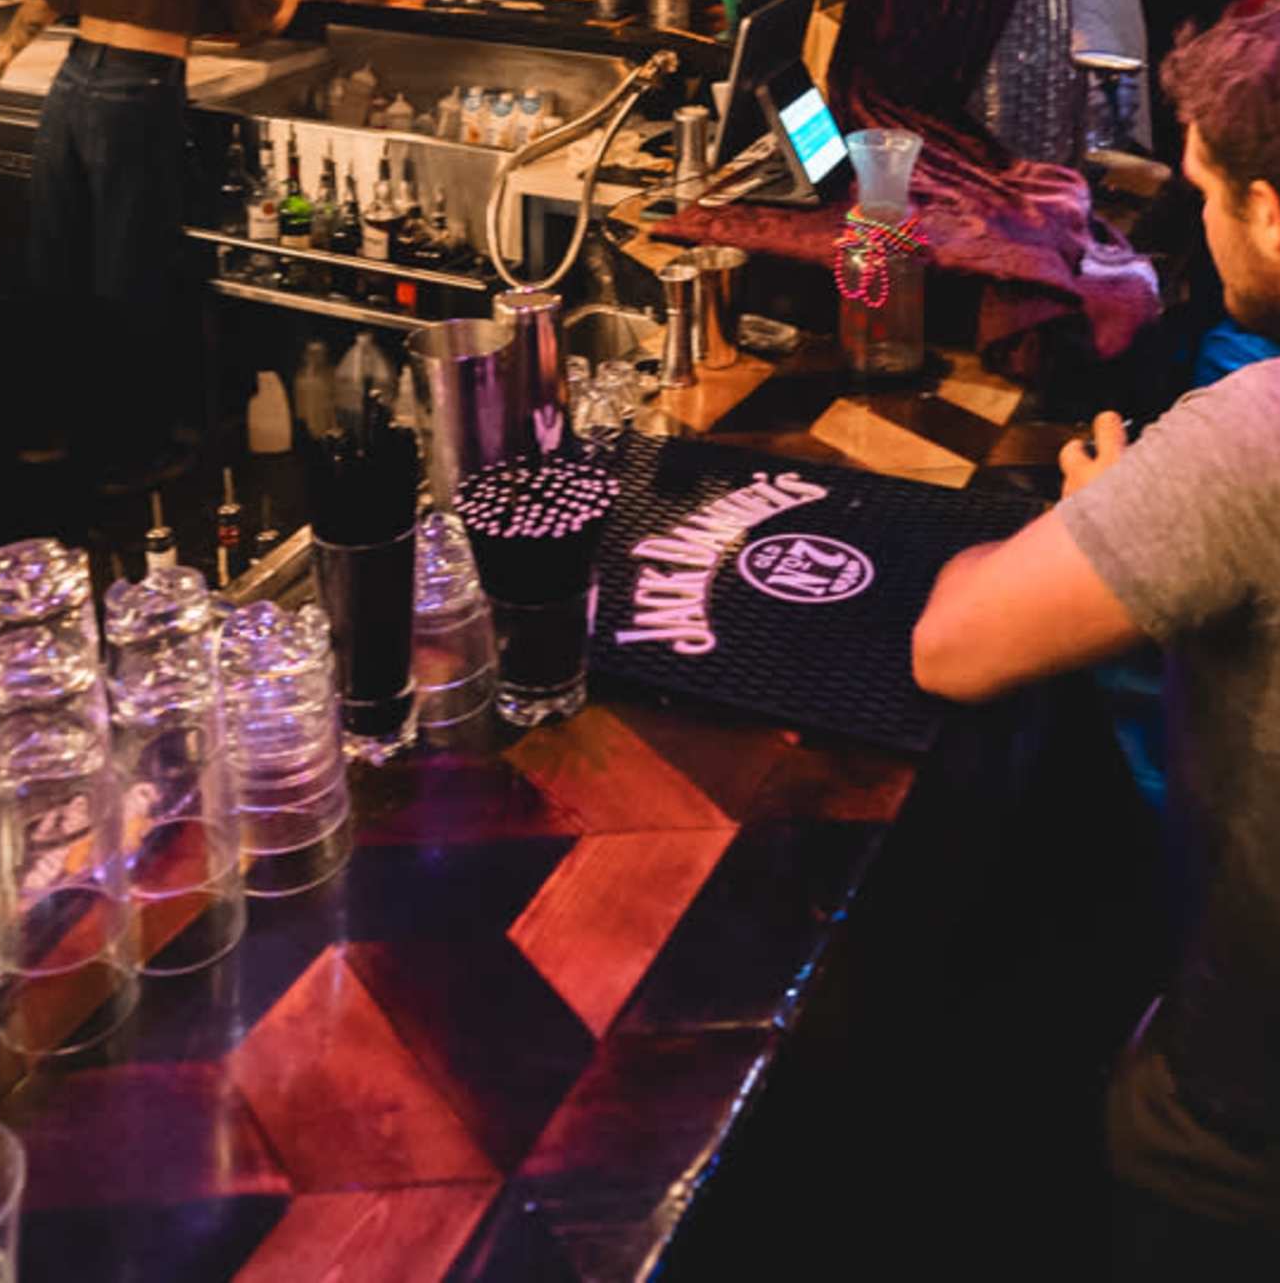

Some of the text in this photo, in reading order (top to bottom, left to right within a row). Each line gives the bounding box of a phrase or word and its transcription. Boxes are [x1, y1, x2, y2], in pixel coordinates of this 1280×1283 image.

[614, 471, 829, 655] JACK DANIEL'S
[786, 539, 848, 568] 7
